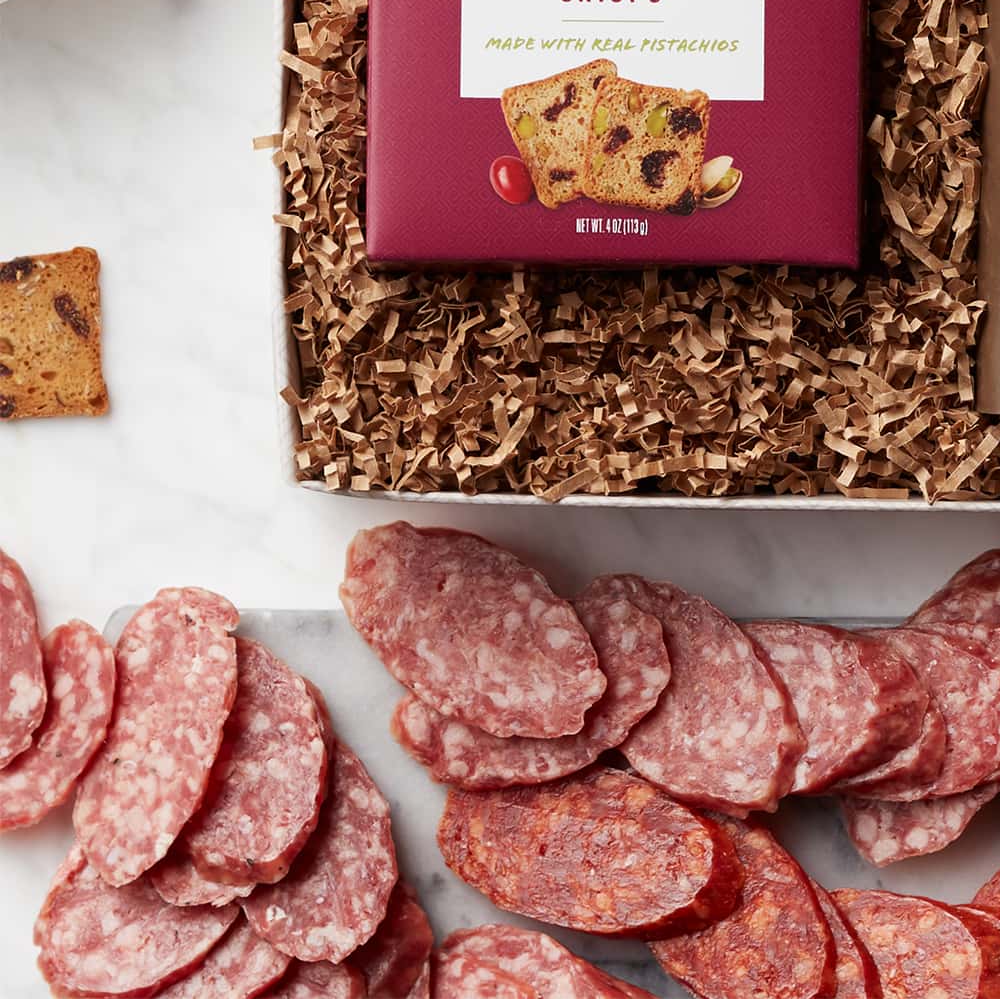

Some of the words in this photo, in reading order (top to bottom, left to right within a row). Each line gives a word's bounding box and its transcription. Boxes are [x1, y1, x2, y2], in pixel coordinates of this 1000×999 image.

[485, 37, 535, 51] MADE
[541, 37, 587, 51] WITH
[591, 38, 636, 51] REAL
[640, 38, 740, 53] PISTACHIOS
[576, 218, 590, 233] NET
[606, 218, 612, 233] 4
[612, 218, 623, 233] OZ
